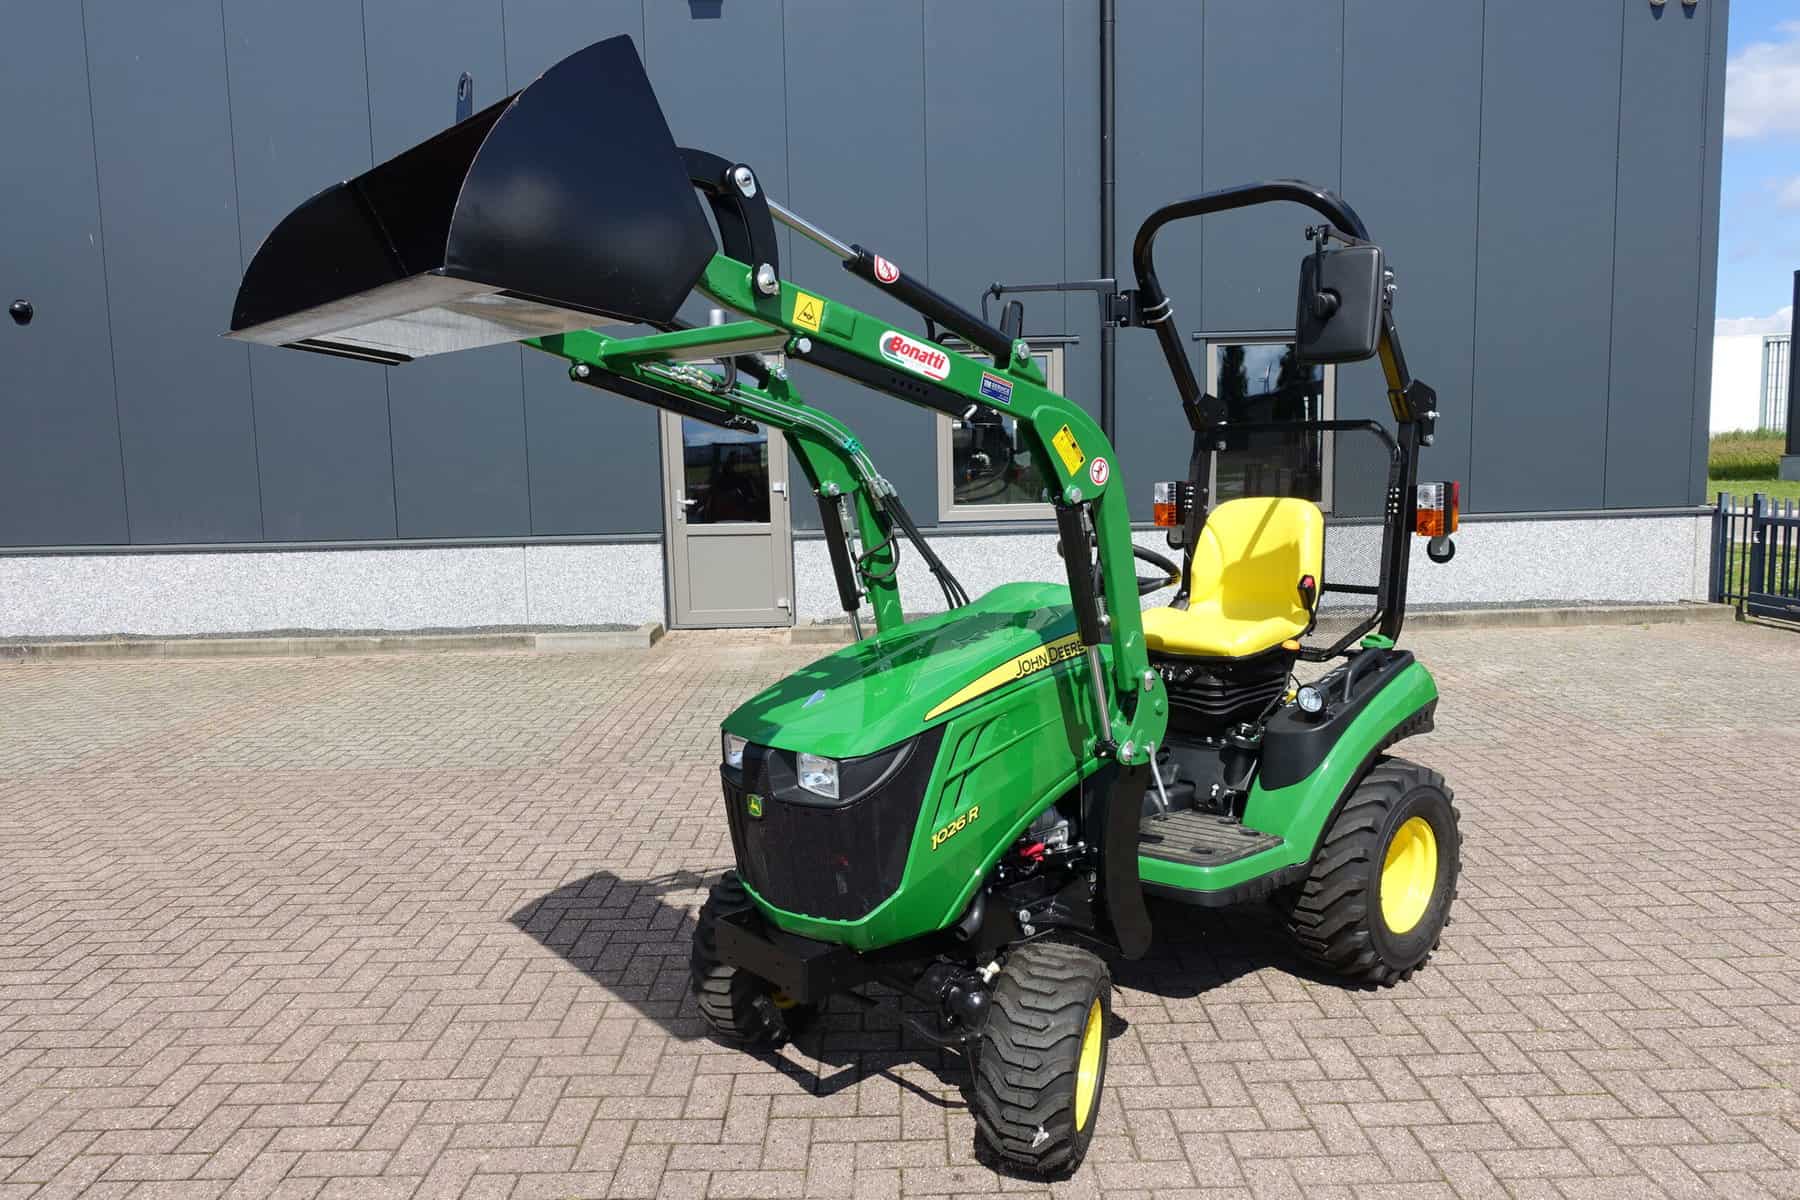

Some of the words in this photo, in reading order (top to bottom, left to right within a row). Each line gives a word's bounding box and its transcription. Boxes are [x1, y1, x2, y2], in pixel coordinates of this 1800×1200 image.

[889, 335, 946, 370] Bonatti
[1015, 652, 1048, 676] JOHN
[1048, 640, 1085, 662] DEERE
[931, 814, 967, 850] 1026
[967, 805, 980, 824] R
